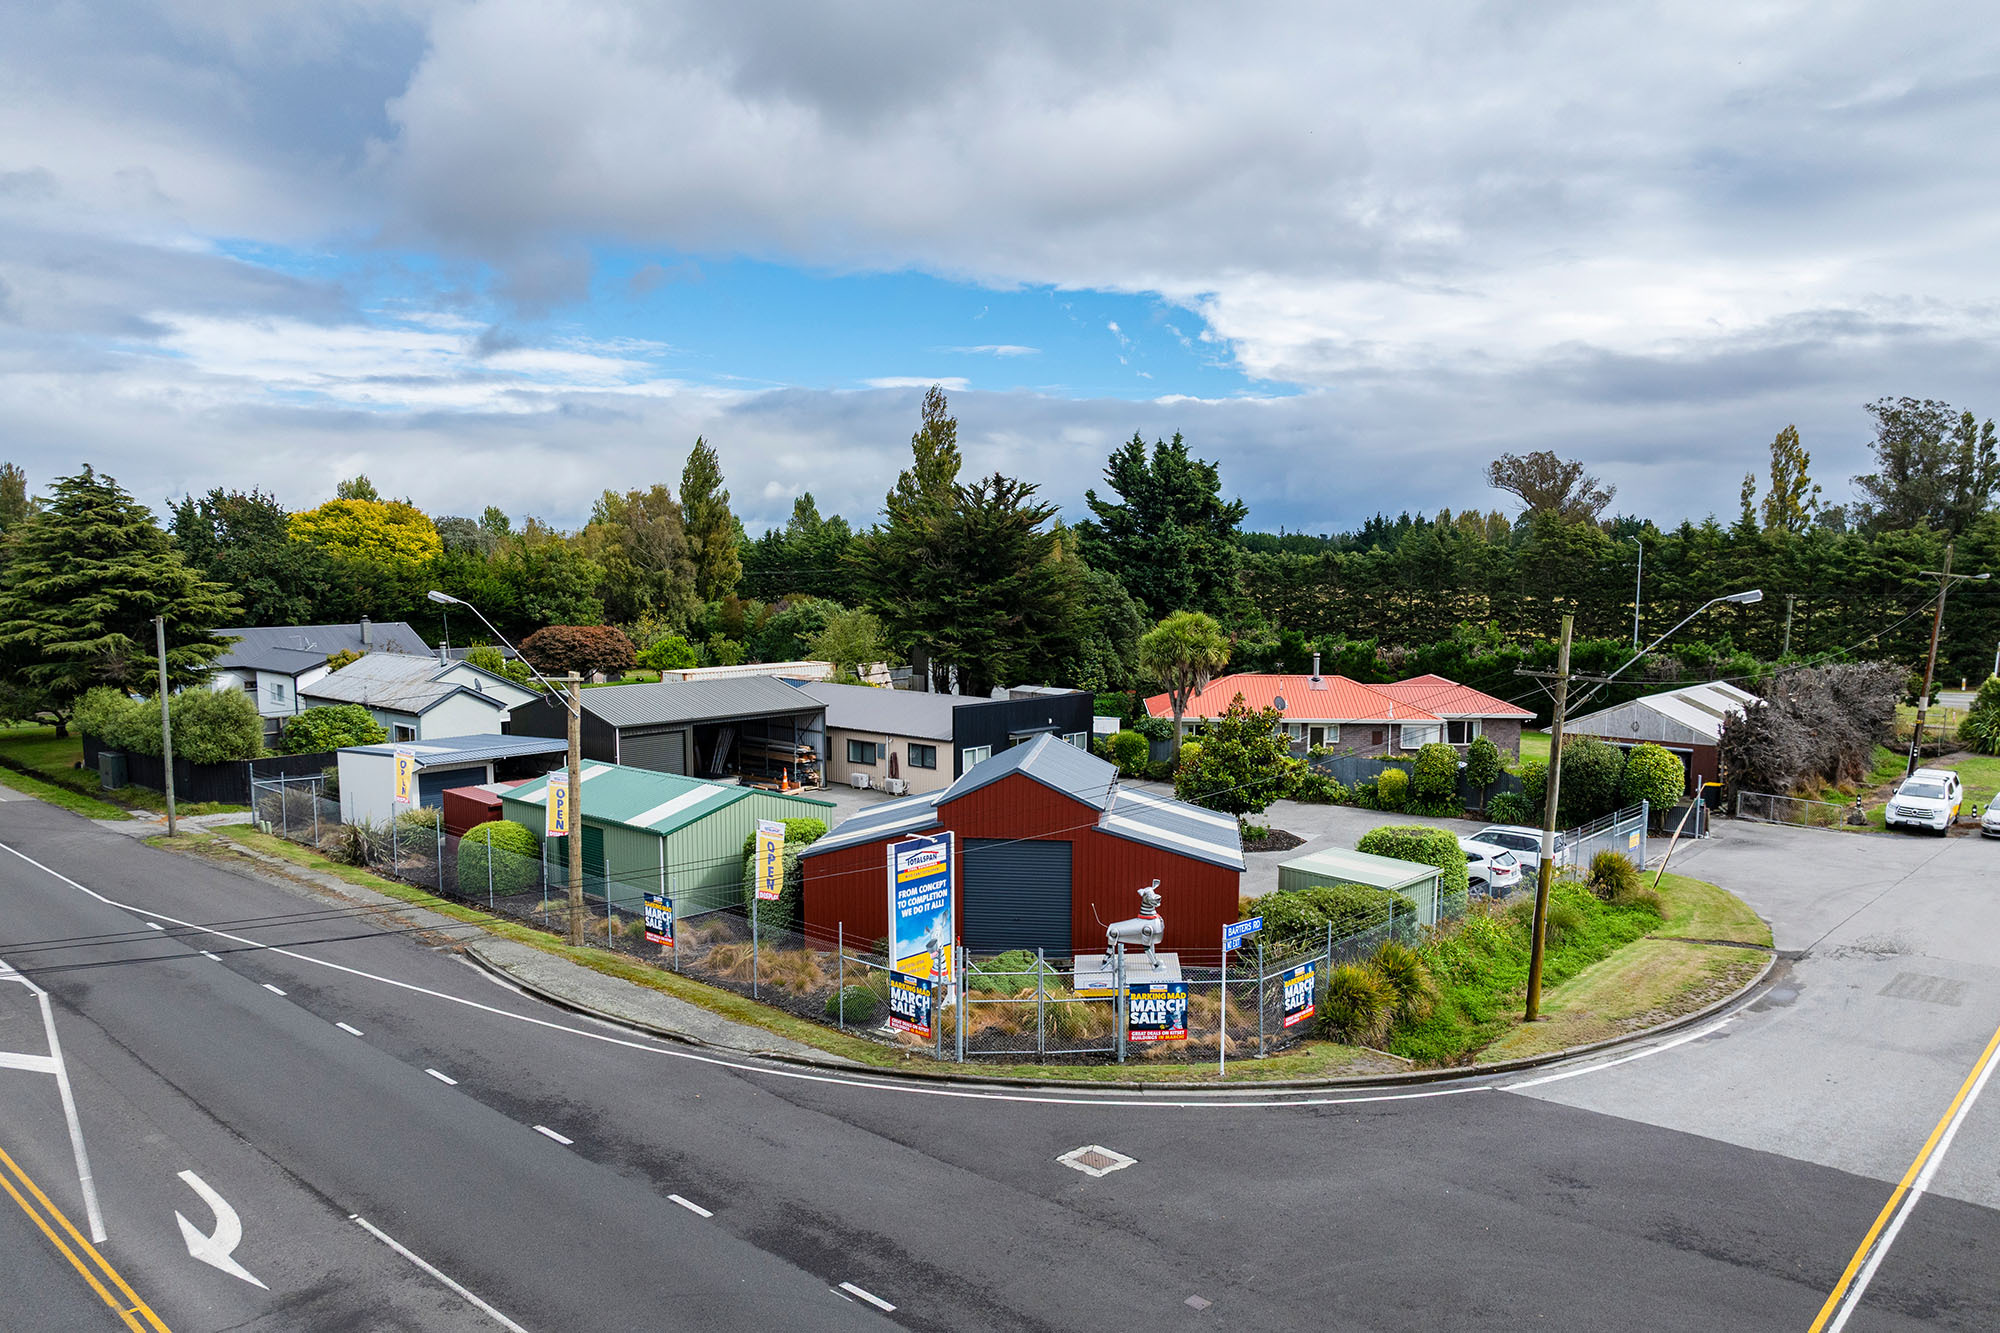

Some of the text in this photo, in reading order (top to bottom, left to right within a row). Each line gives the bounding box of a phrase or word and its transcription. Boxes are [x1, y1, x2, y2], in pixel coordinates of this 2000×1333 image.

[556, 789, 565, 830] OPEN
[767, 841, 776, 891] OPEN
[906, 853, 938, 866] TOTALSPAN
[898, 879, 947, 899] FROM CONCEPT
[897, 889, 947, 909] TO COMPLETION
[645, 906, 672, 923] MARCH
[901, 899, 944, 918] WE DO IT ALL!
[645, 917, 663, 930] SALE
[1228, 920, 1260, 936] BARTERS RD
[1227, 940, 1232, 948] NO
[891, 980, 931, 997] BARKING MAD
[1167, 992, 1186, 1000] MAD
[1285, 976, 1314, 999] MARCH
[891, 987, 930, 1009] MARCH
[1130, 999, 1186, 1012] MARCH
[1285, 993, 1304, 1011] SALE
[891, 998, 916, 1017] SALE
[1130, 1012, 1166, 1024] SALE
